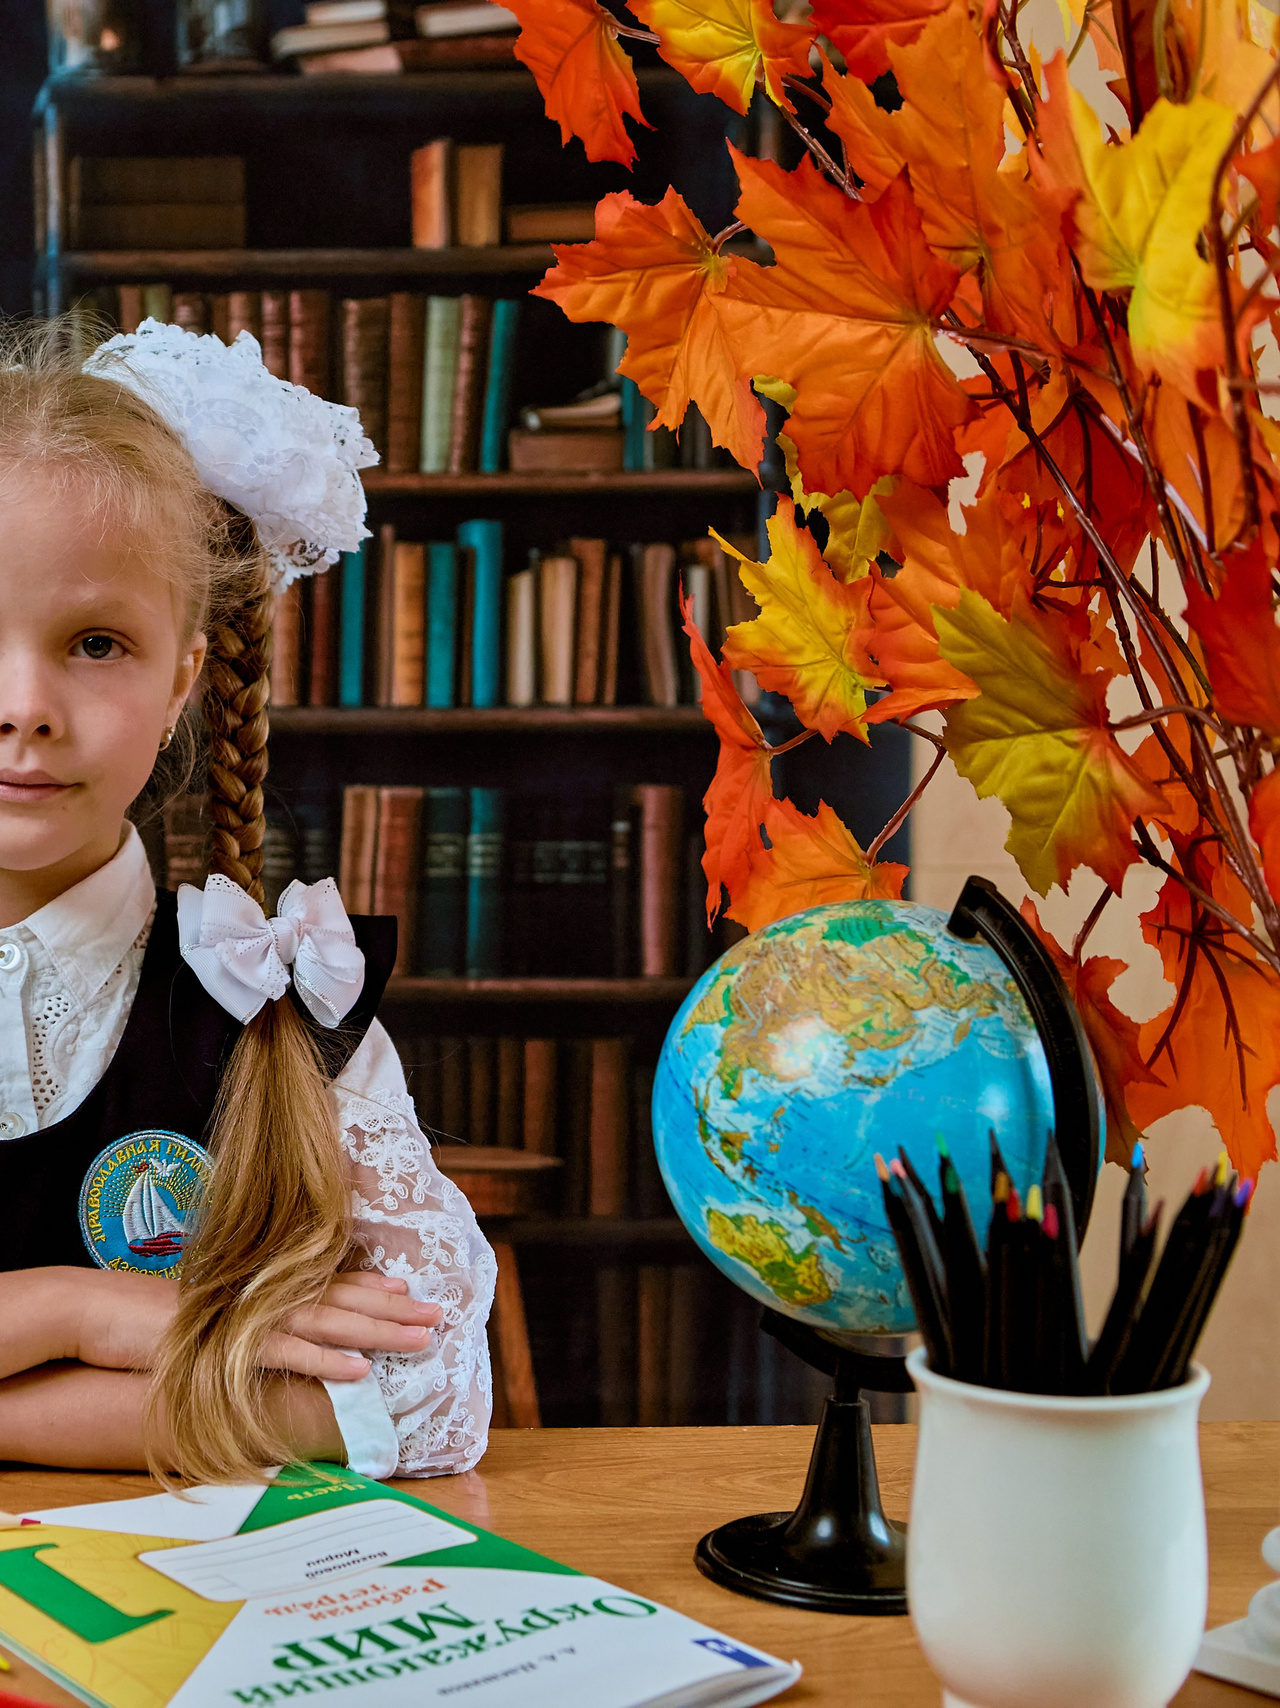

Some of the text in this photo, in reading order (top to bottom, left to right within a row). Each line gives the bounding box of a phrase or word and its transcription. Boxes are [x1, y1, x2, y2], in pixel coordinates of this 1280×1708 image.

[286, 1483, 367, 1500] Часть
[263, 1582, 389, 1617] тетрадь
[308, 1576, 450, 1622] Рабочая
[228, 1596, 658, 1708] Окружающий
[272, 1601, 489, 1673] МИР
